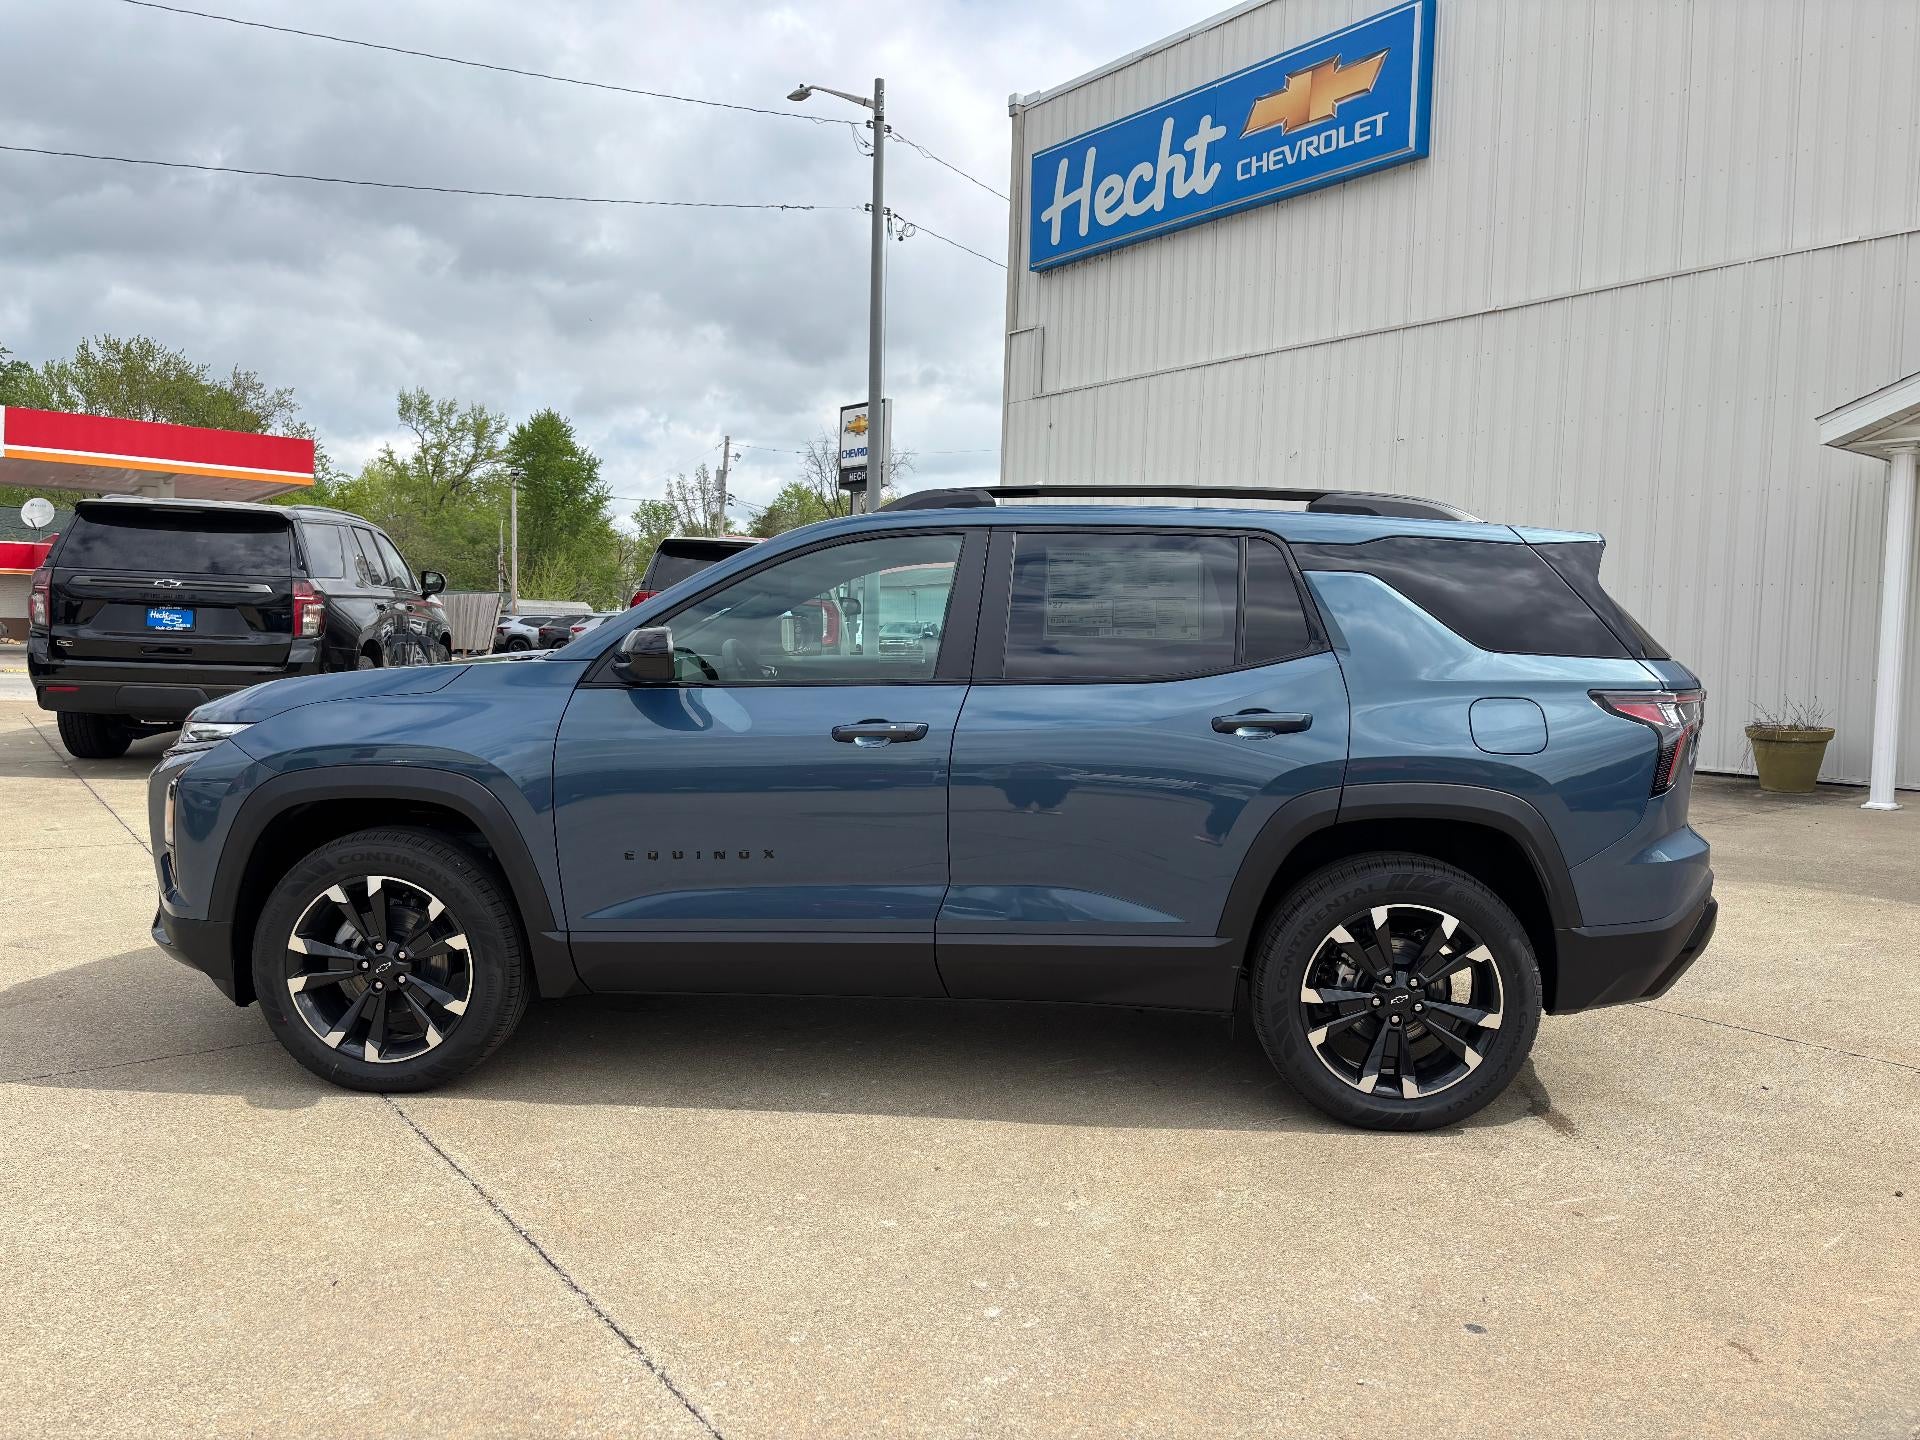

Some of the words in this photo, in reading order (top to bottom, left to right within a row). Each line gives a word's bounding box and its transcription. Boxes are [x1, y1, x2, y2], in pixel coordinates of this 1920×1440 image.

[1236, 111, 1390, 182] CHEVROLET
[1040, 114, 1227, 246] Hecht
[841, 447, 868, 459] CHEVRO
[849, 471, 867, 482] HECH
[623, 849, 775, 861] EQUINOX
[1277, 884, 1383, 993] CONTINENTAL
